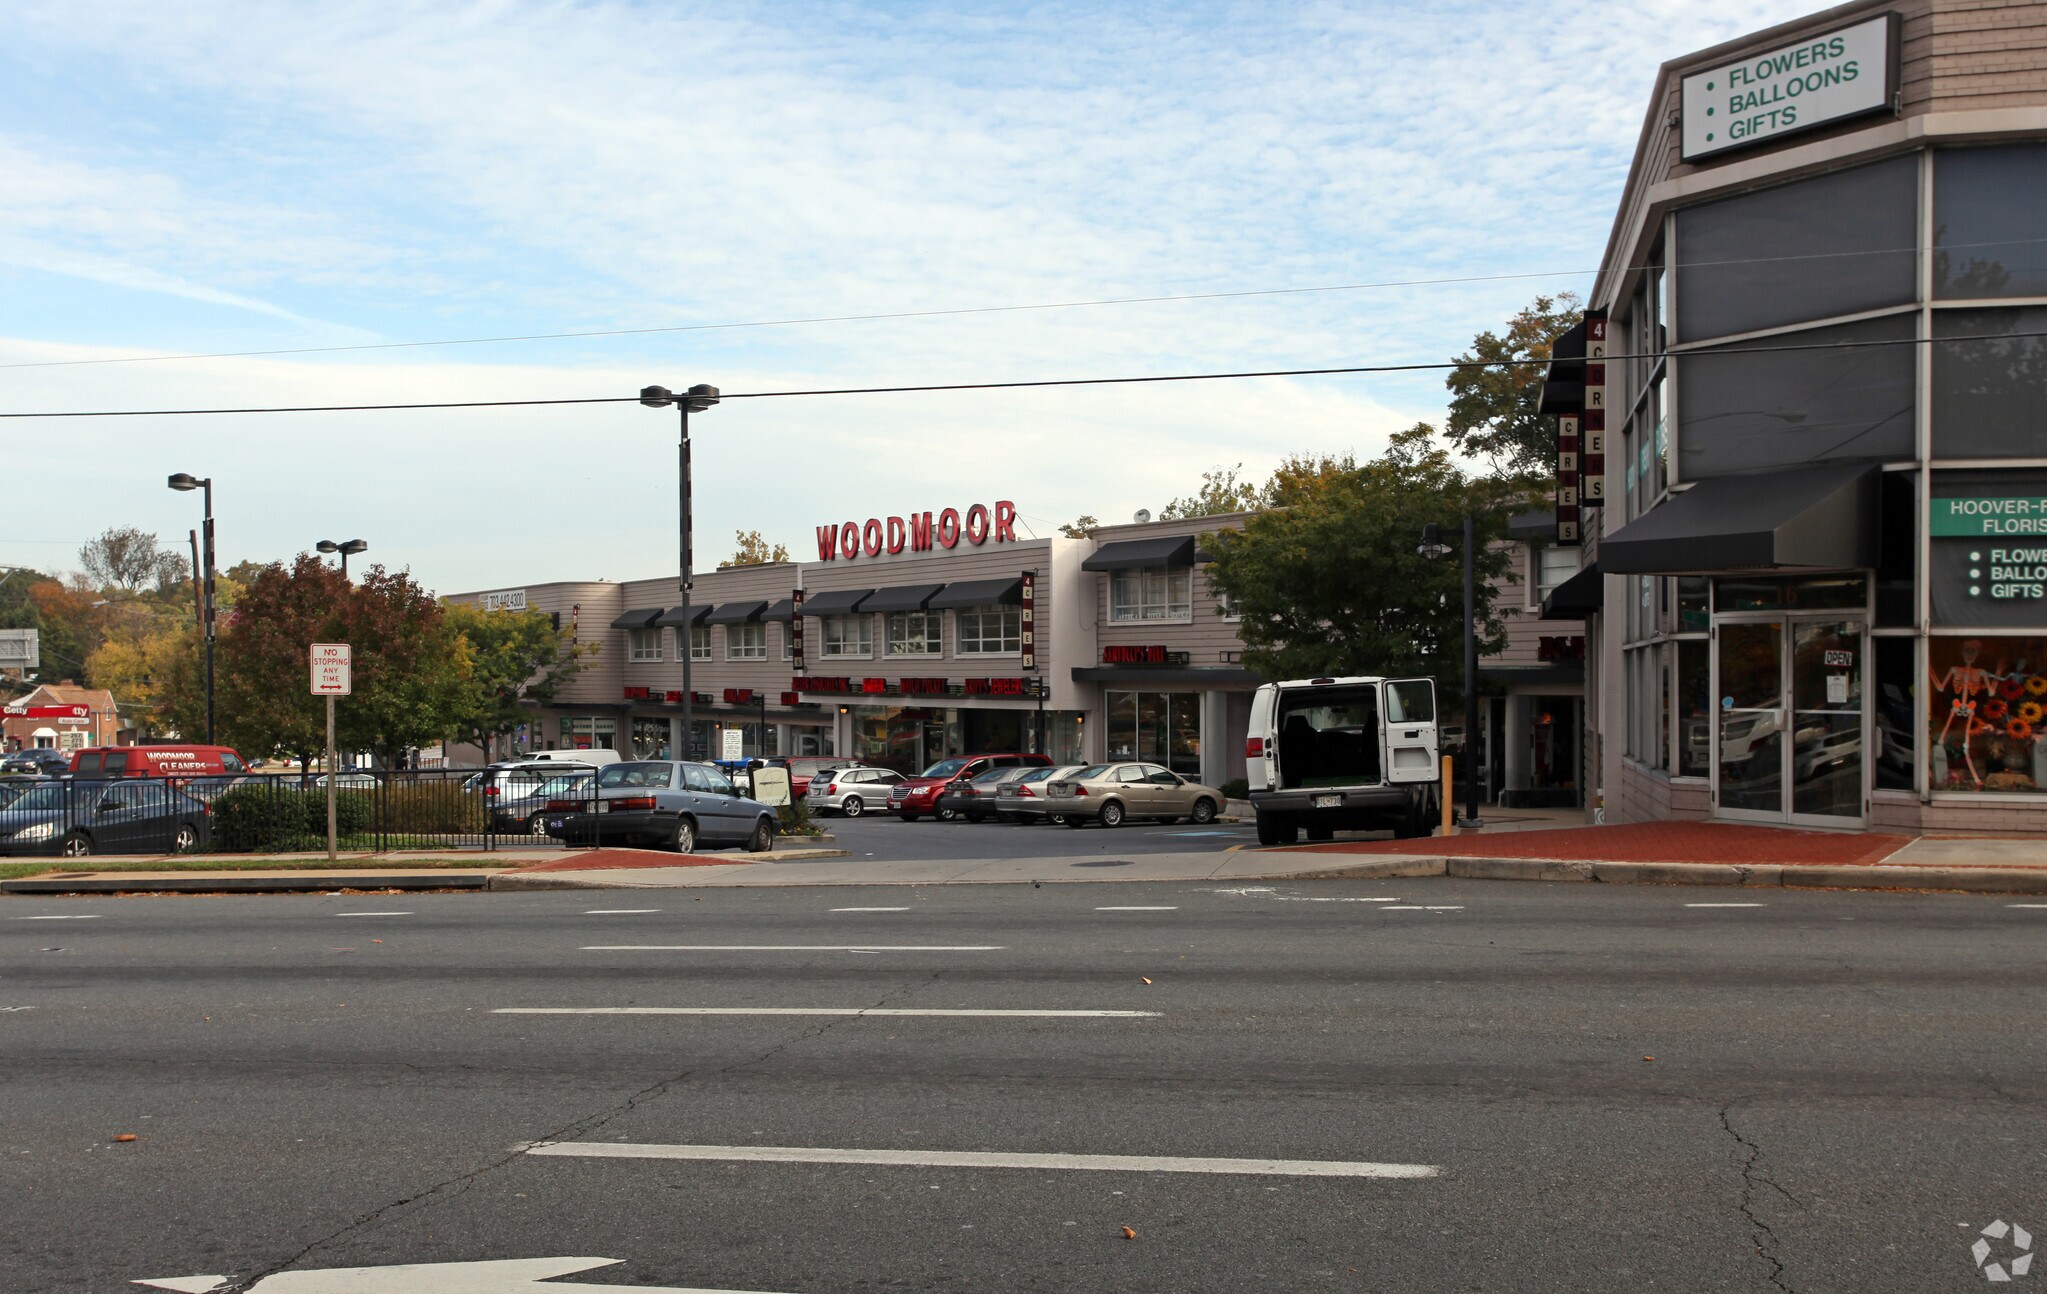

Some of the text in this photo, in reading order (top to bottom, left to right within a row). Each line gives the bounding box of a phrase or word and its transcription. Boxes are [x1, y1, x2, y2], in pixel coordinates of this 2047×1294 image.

[1729, 37, 1845, 89] FLOWERS
[1729, 61, 1859, 115] BALLOONS
[1729, 106, 1797, 140] GIFTS
[1593, 323, 1603, 338] 4
[816, 500, 1016, 562] WOODMOOR
[1991, 583, 2044, 598] GIFTS
[323, 648, 338, 656] NO
[314, 657, 348, 666] STOPPING
[3, 706, 28, 715] Getty
[146, 752, 195, 764] WOODMOOR
[160, 762, 207, 774] CLEANERS
